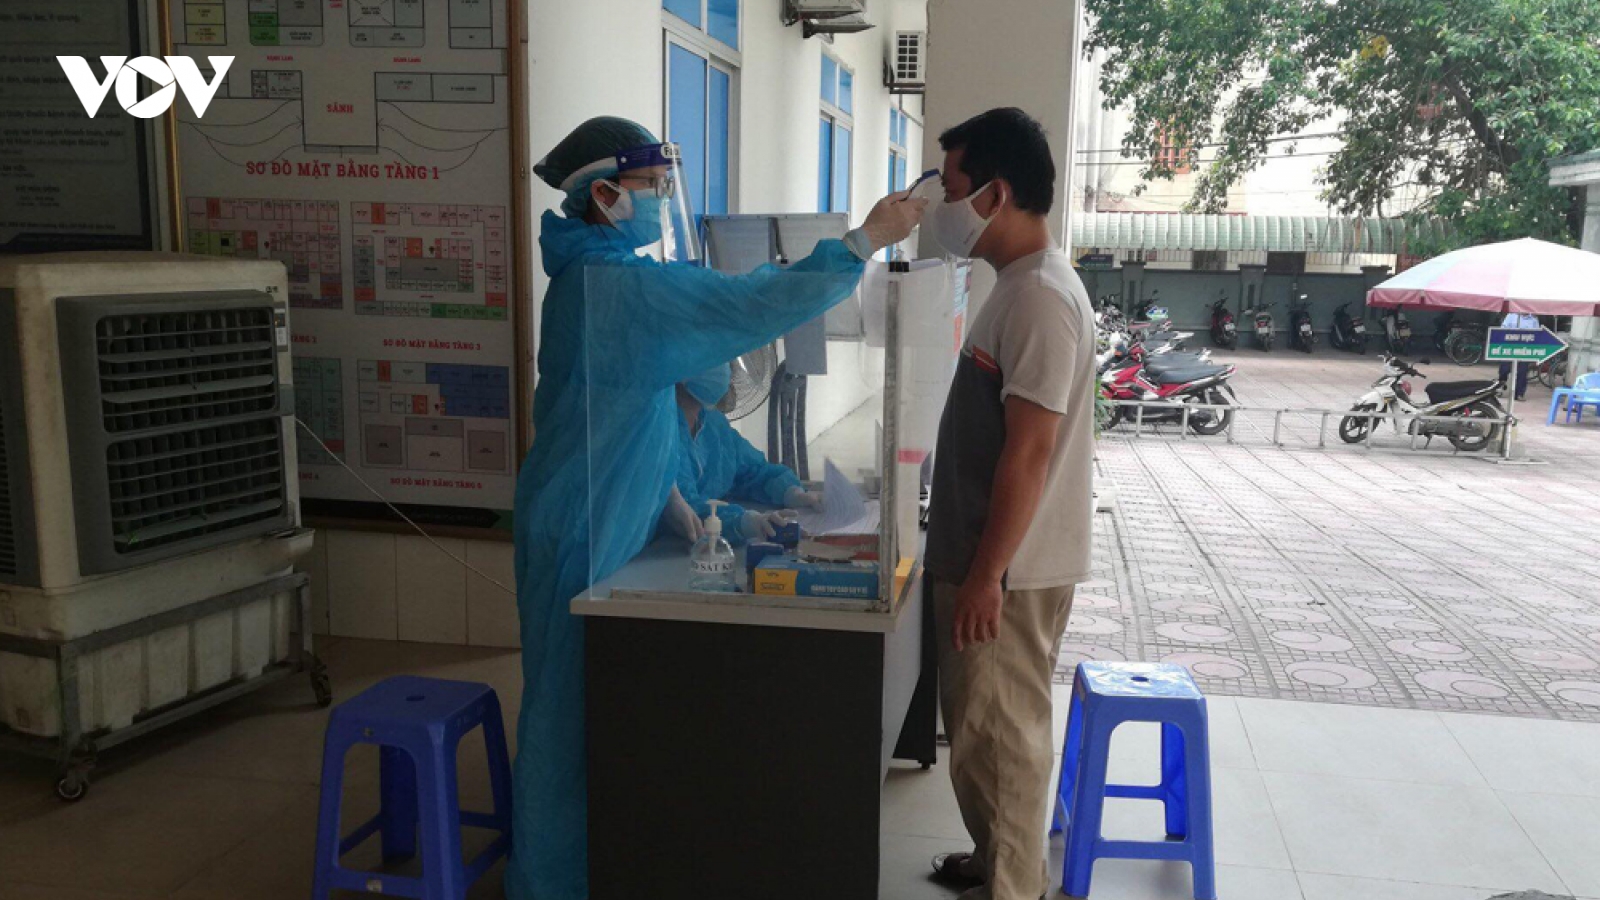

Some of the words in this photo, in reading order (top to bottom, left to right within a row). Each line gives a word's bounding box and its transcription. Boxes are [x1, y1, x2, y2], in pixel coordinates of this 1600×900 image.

[246, 160, 267, 175] SƠ
[271, 156, 292, 175] ĐỒ
[297, 159, 331, 179] MẶT
[336, 157, 379, 178] BẰNG
[385, 160, 428, 179] TẦNG
[431, 166, 440, 180] 1
